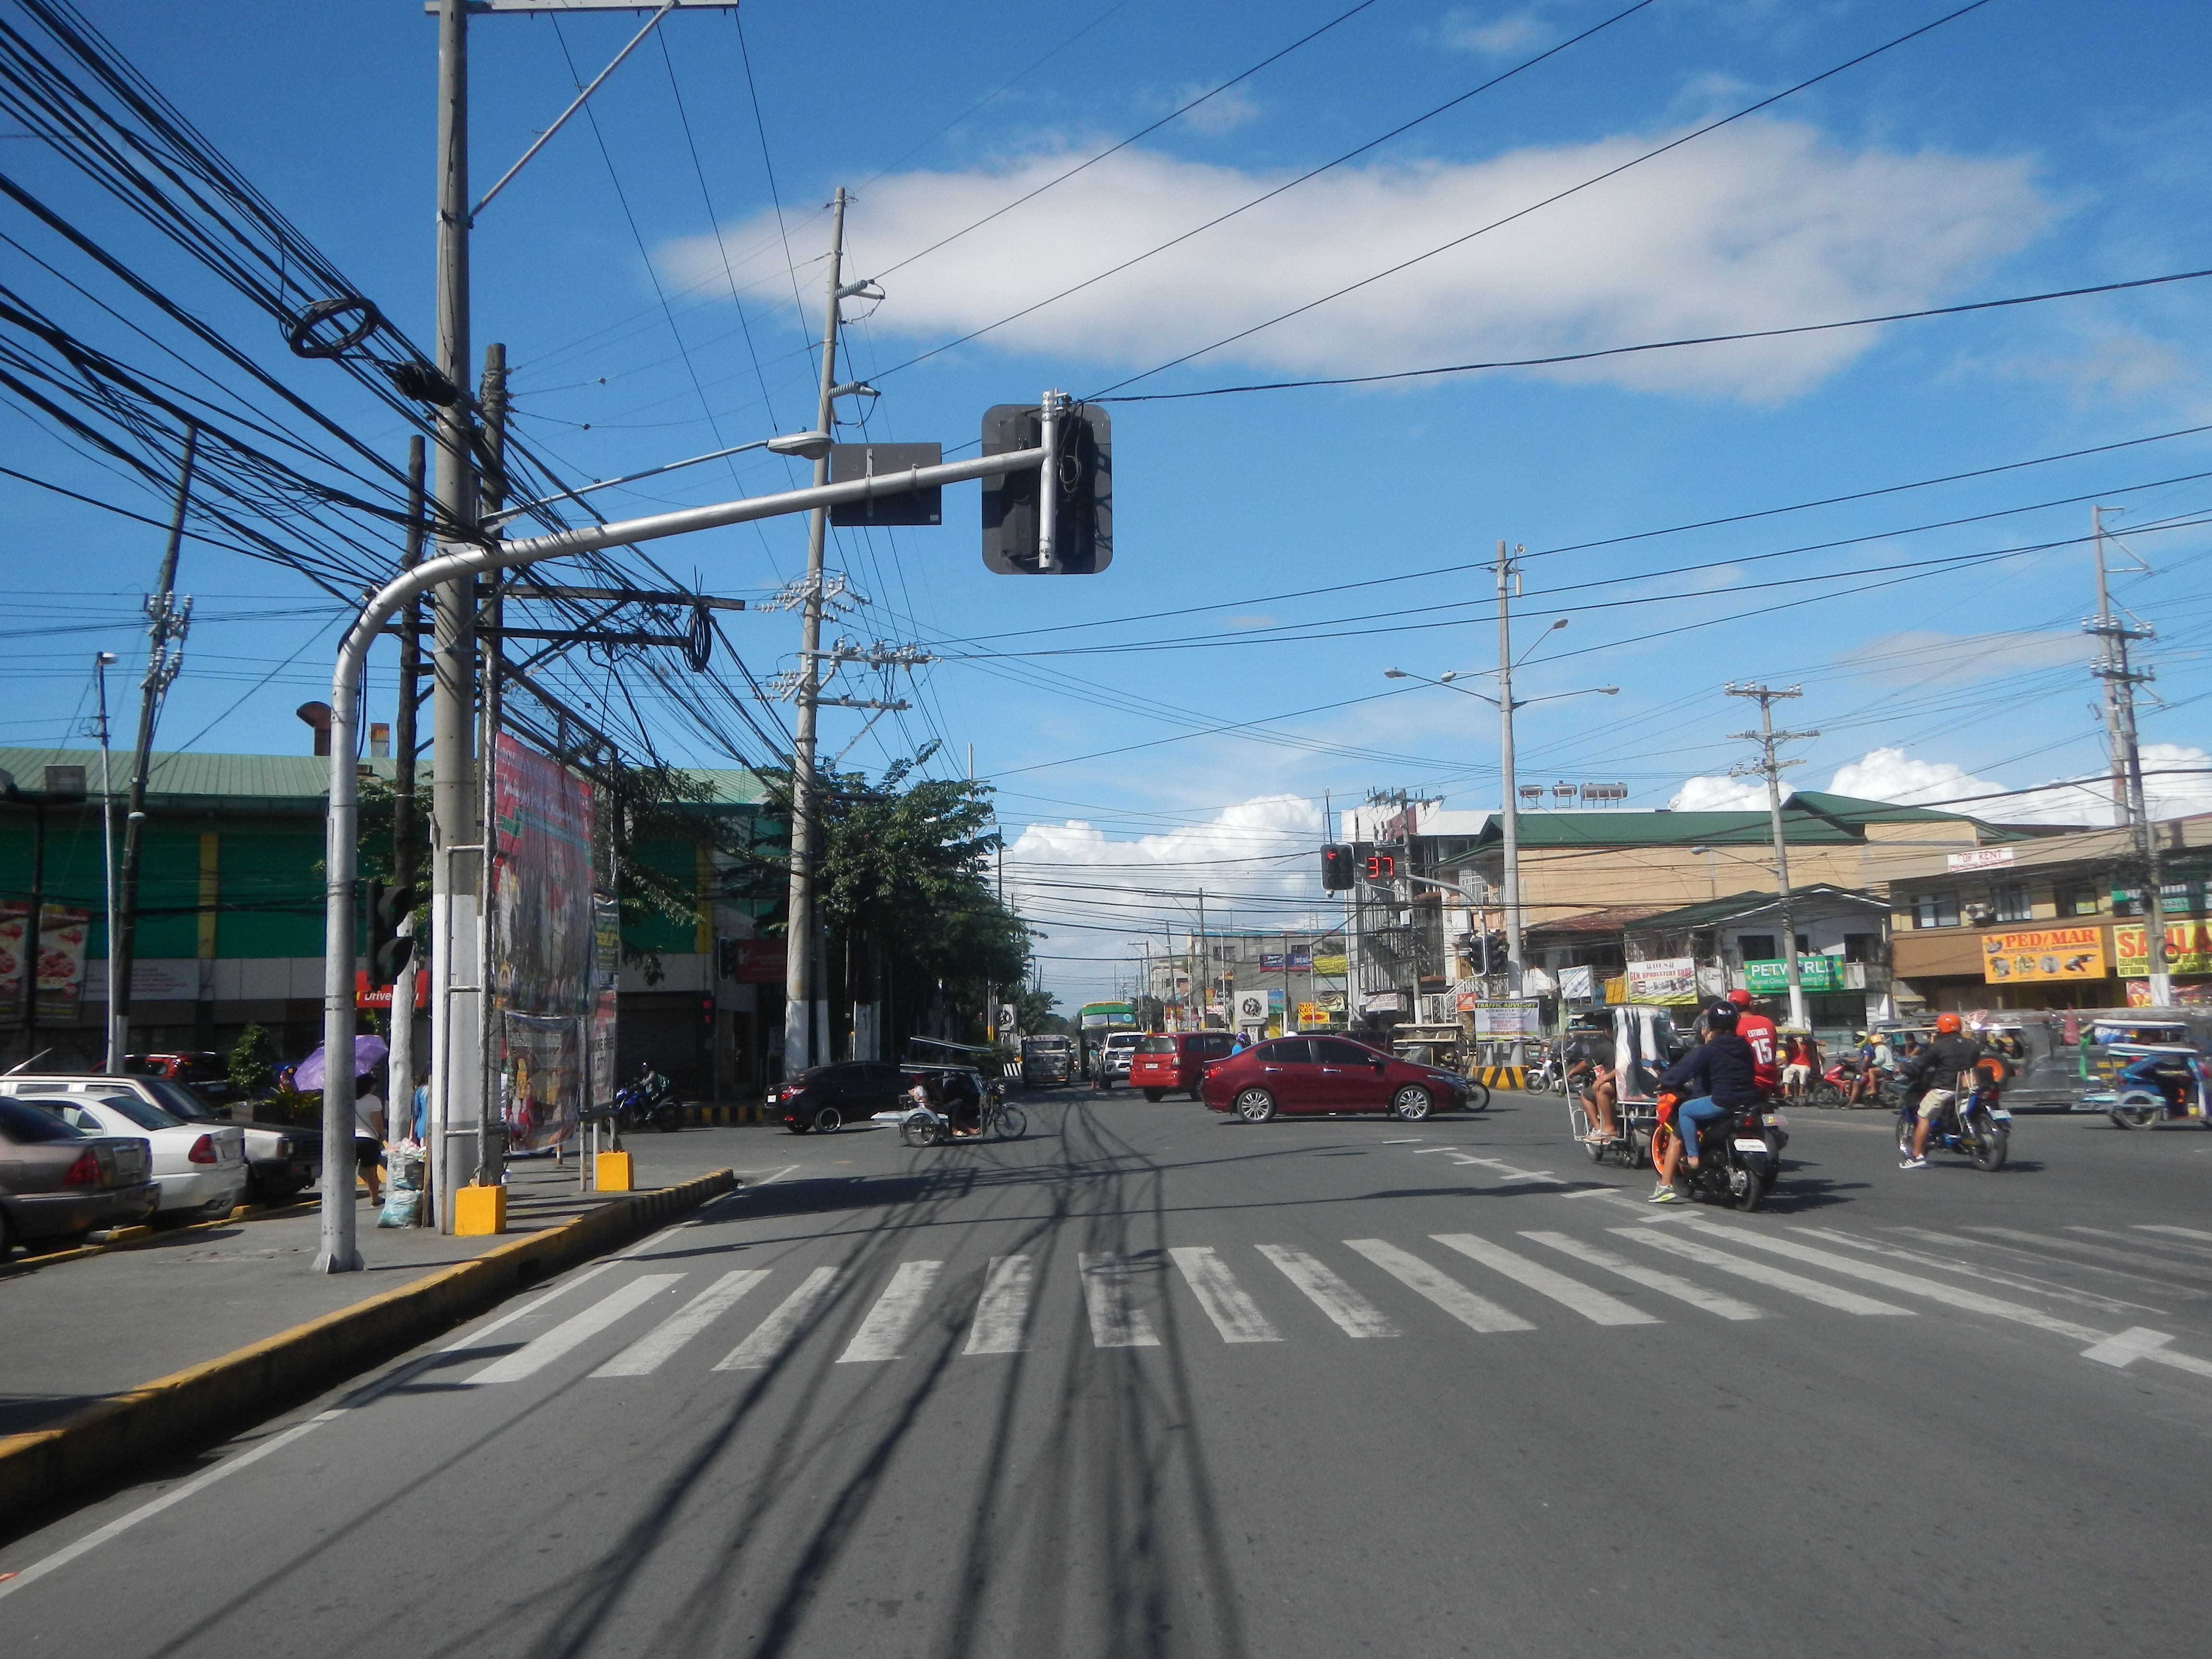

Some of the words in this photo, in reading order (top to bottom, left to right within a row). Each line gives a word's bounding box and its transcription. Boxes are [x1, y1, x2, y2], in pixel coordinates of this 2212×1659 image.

[1979, 850, 2002, 860] RENT
[1368, 857, 1393, 878] 37
[1642, 970, 1676, 979] UPHOLSTERY
[1677, 968, 1692, 977] SHOP
[364, 990, 391, 1000] Drive
[1751, 1038, 1772, 1064] 15
